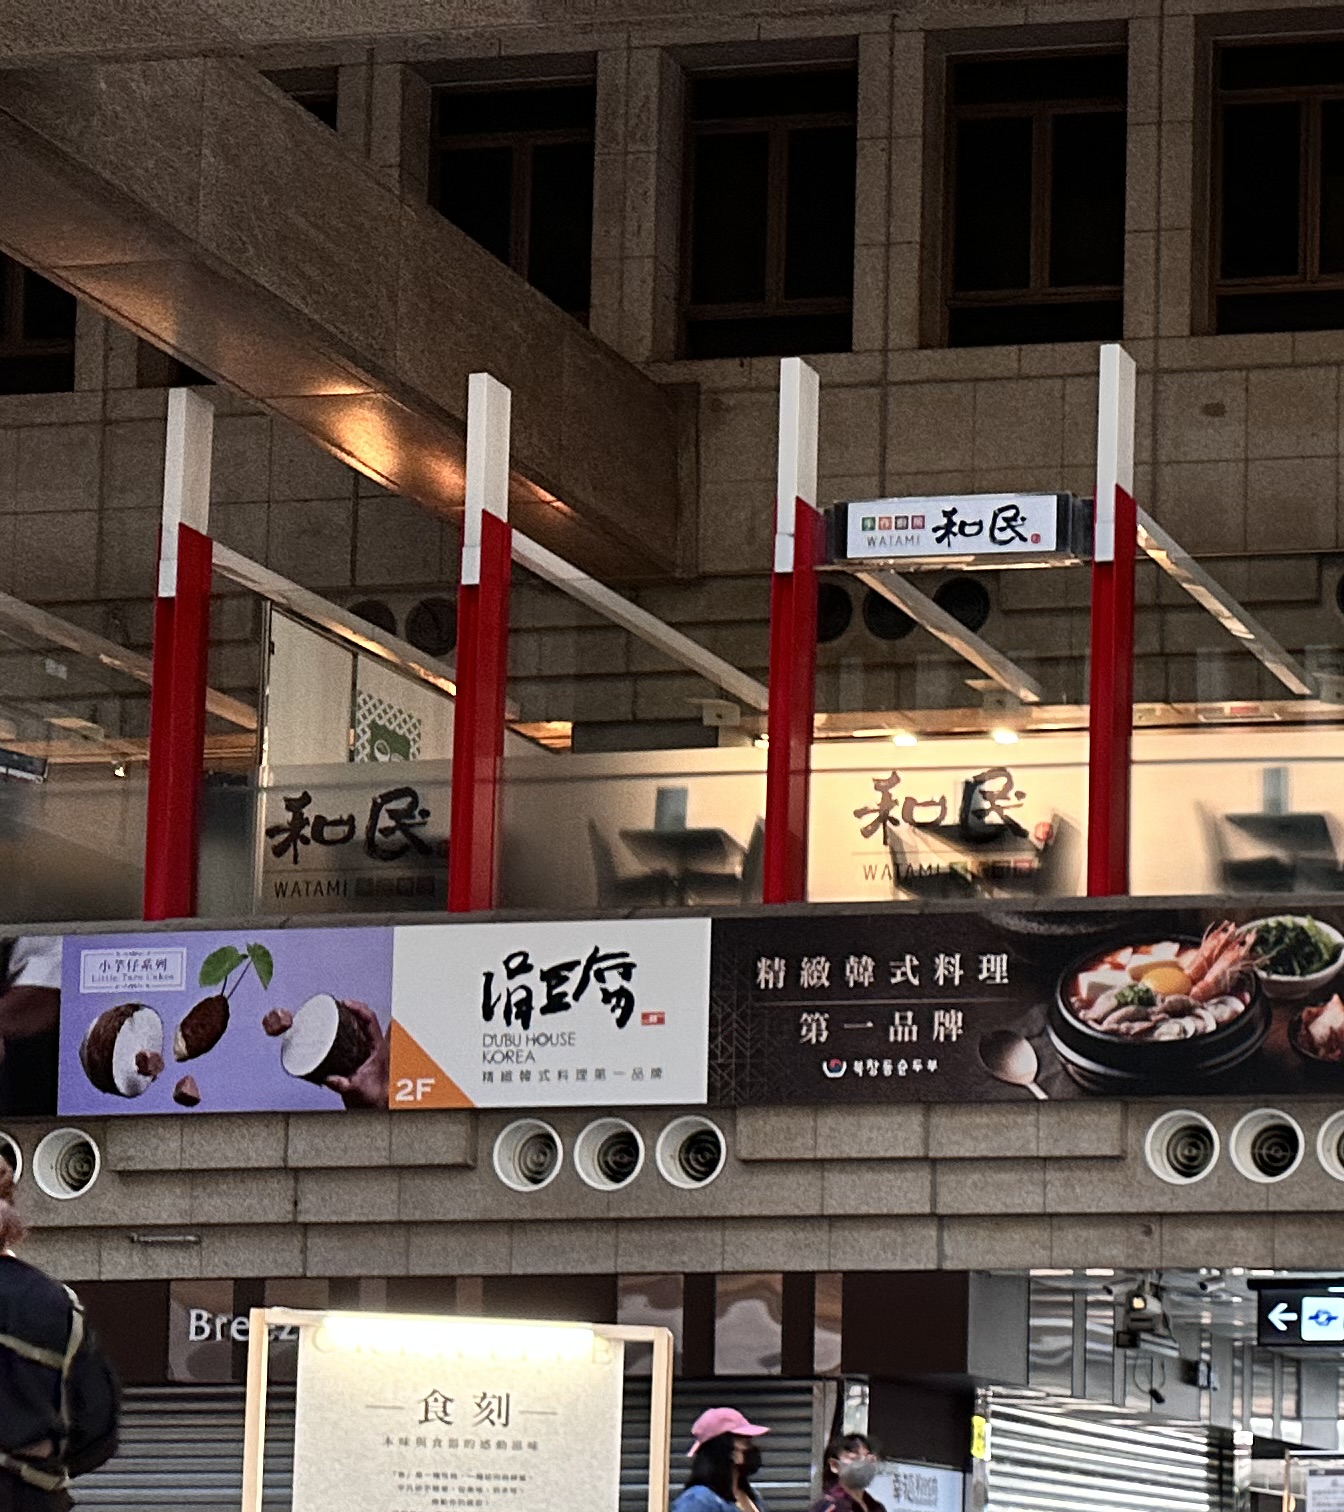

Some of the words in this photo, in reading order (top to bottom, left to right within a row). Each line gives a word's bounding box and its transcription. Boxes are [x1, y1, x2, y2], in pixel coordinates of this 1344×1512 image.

[931, 504, 1028, 547] 和民
[866, 534, 921, 547] WATAMI
[853, 767, 1029, 845] 和民
[265, 787, 431, 864] 和民
[862, 862, 941, 882] WATAMI
[273, 879, 348, 899] WATAMI
[756, 953, 1010, 990] 精緻韓式料理
[482, 1033, 522, 1048] DUBU
[526, 1031, 576, 1047] HOUSE
[799, 1009, 965, 1045] 第一品牌
[482, 1050, 536, 1064] KOREA
[396, 1079, 434, 1101] 2F
[418, 1389, 511, 1428] 食刻
